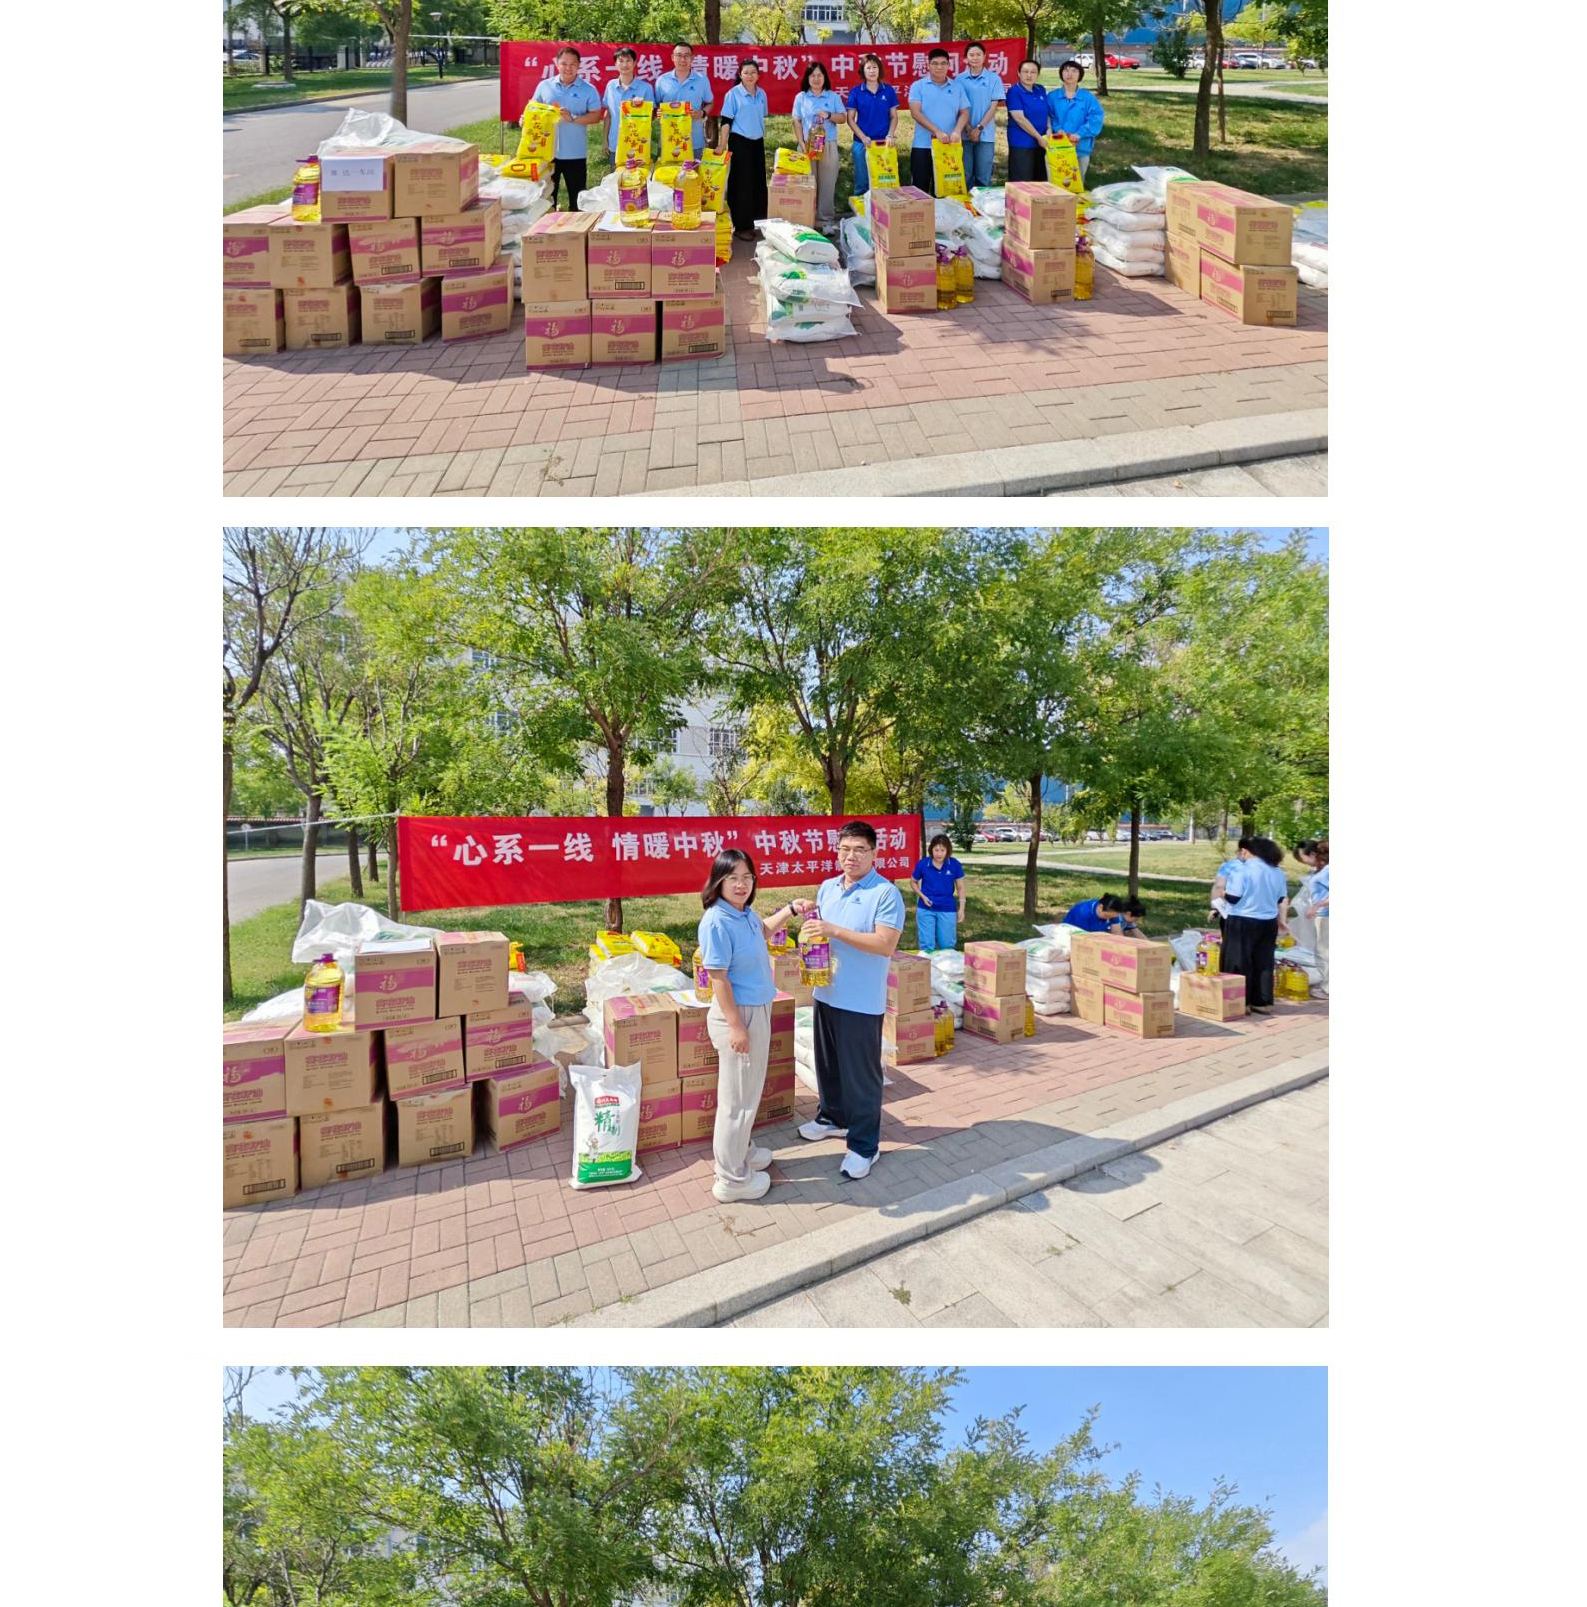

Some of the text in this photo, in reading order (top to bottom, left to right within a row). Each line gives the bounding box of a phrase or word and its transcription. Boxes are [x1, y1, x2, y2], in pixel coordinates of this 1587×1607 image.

[431, 827, 907, 866] “心系一线 情暖中秋” 中秋节慰活动
[760, 857, 910, 876] 天津太平洋限公司
